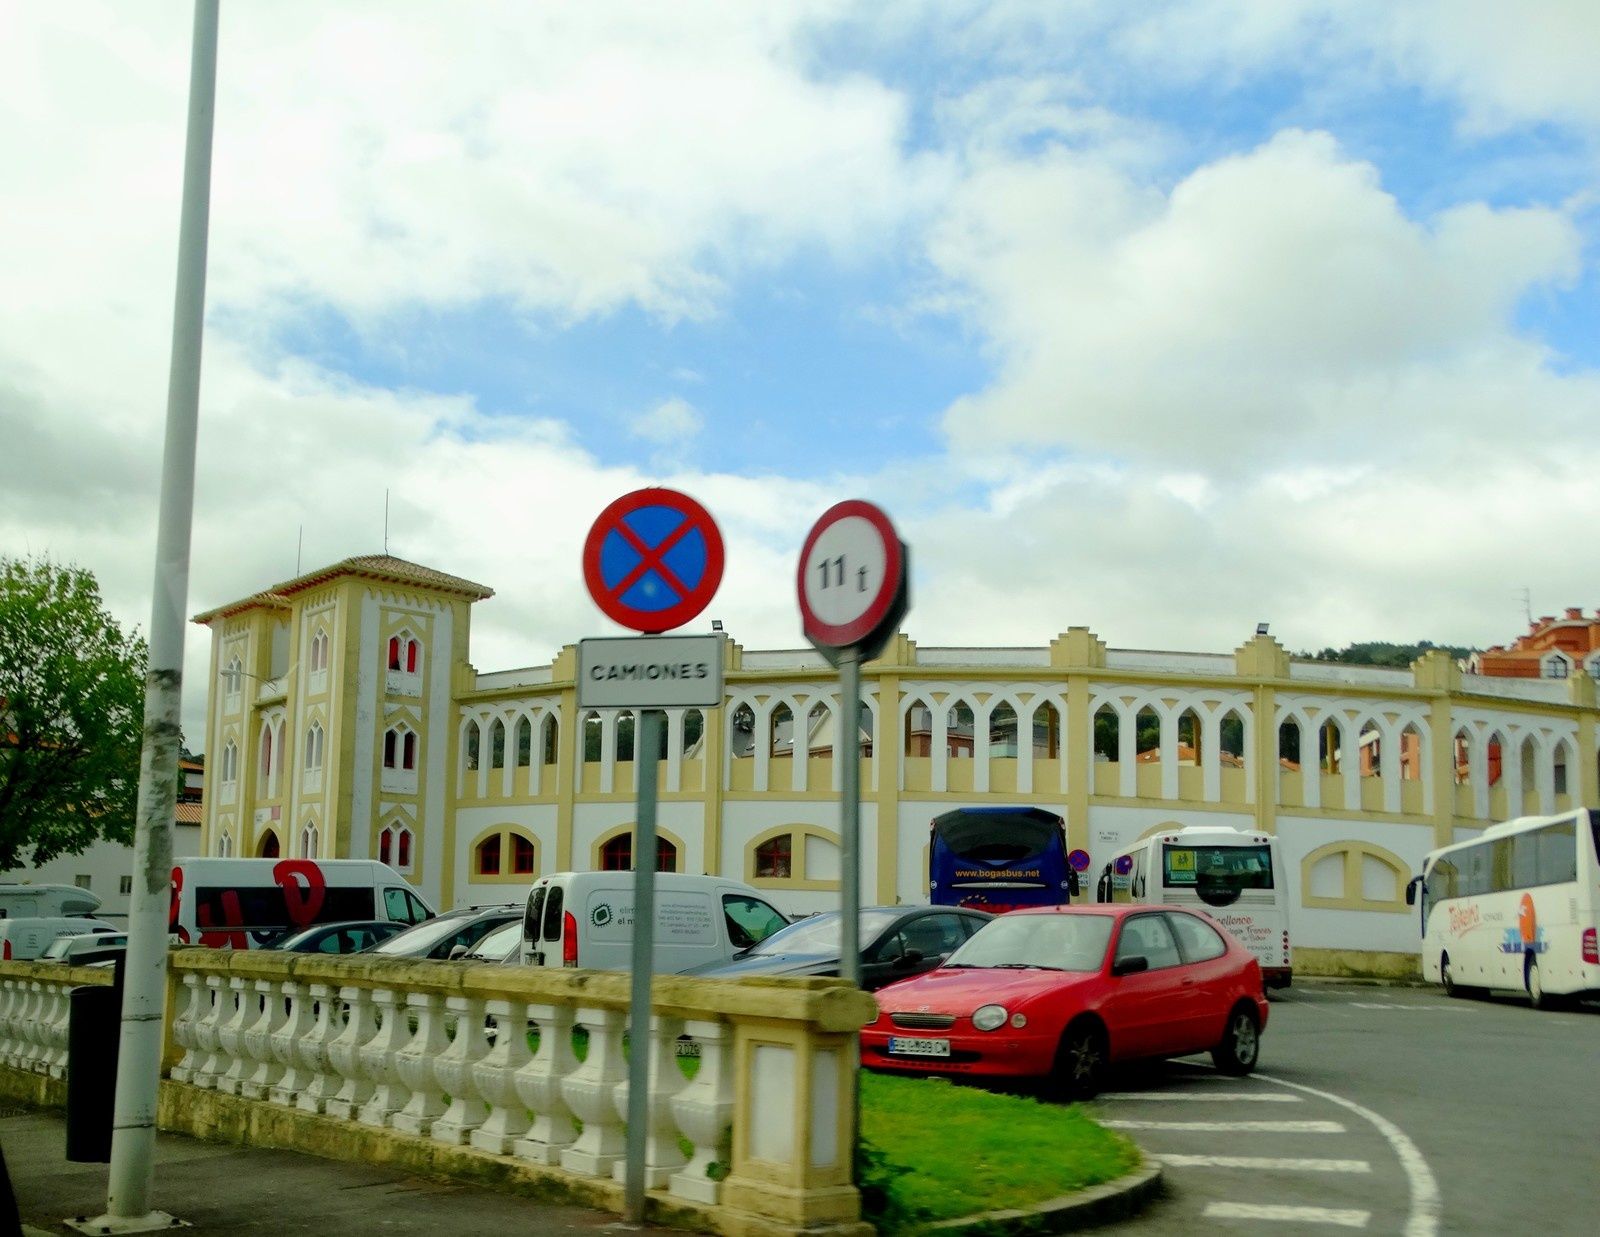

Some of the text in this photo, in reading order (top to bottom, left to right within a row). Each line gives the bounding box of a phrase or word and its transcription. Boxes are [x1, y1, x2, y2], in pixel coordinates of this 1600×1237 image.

[816, 554, 870, 593] 11 t
[590, 663, 710, 680] CAMIONES
[955, 869, 1040, 879] www.bogasbus.net
